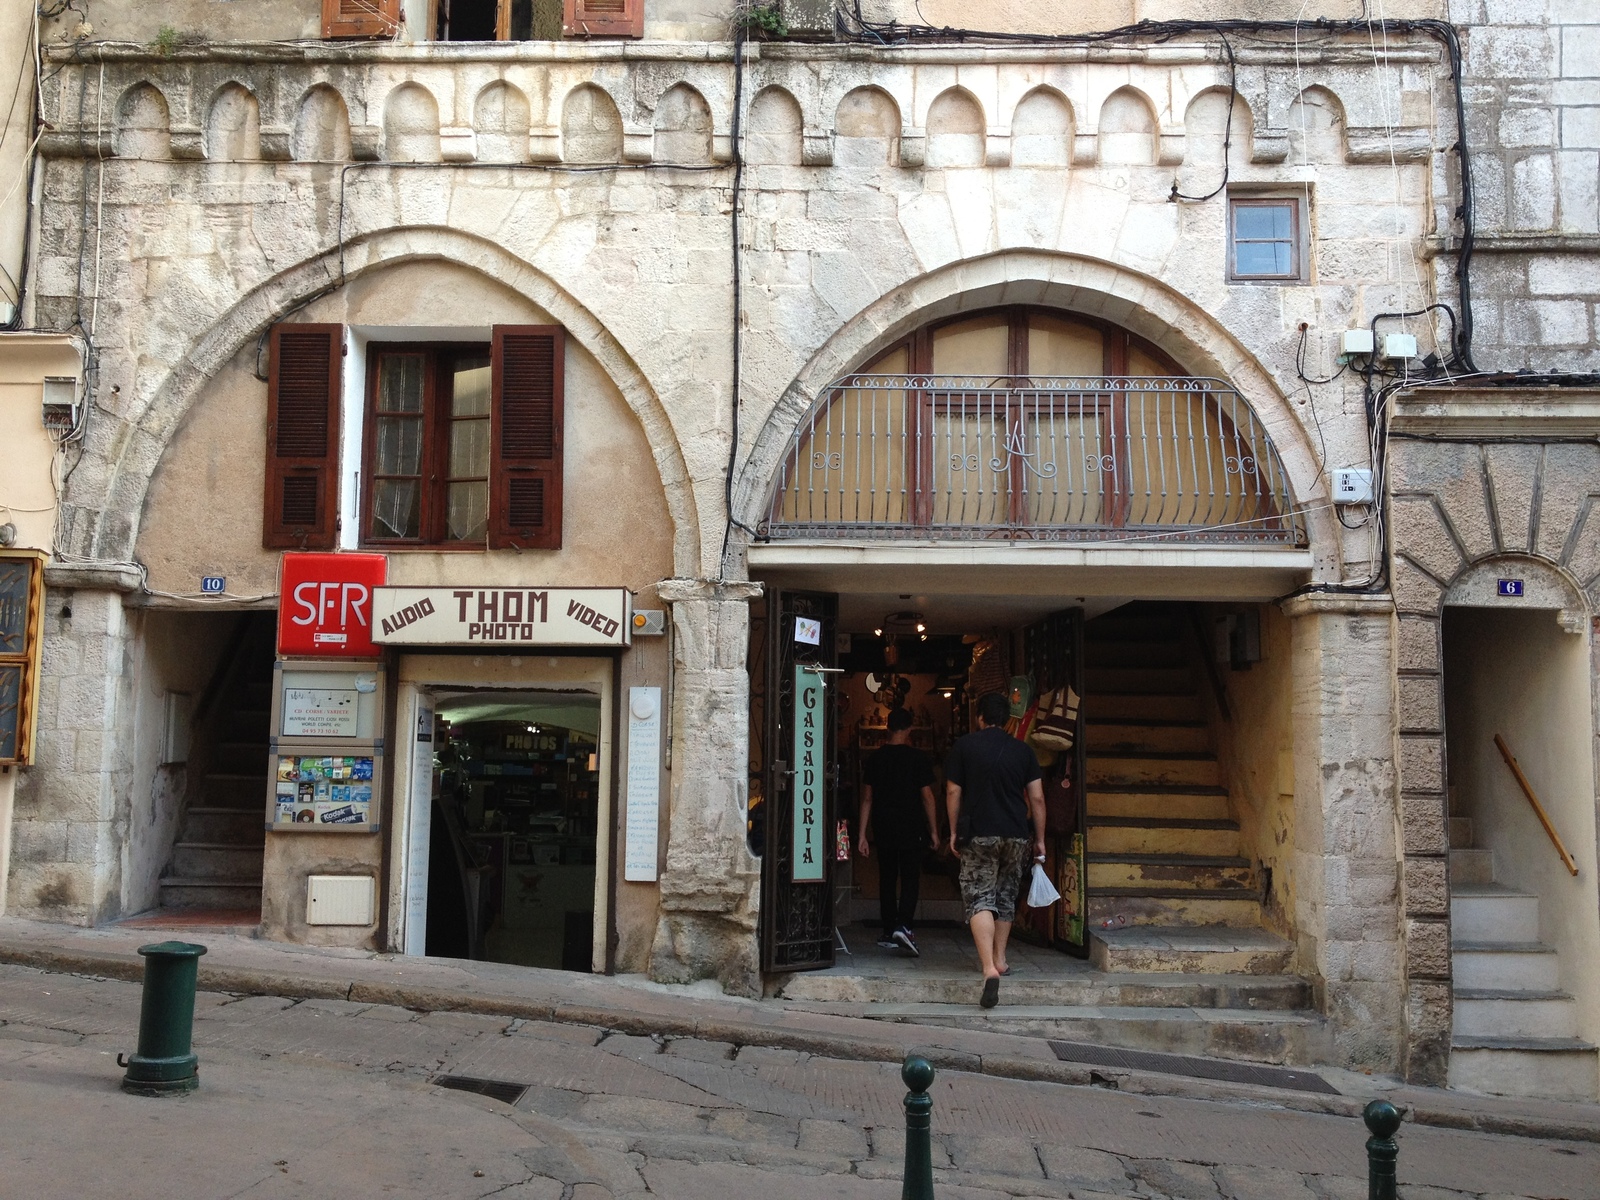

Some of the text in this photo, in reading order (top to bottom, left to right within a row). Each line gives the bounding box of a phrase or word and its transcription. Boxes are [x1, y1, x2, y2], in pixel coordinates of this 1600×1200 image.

[207, 579, 220, 590] 10
[1506, 581, 1516, 594] 6
[291, 582, 368, 626] SFR
[381, 597, 436, 636] AUDIO
[453, 591, 548, 623] THOM
[468, 622, 533, 640] PHOTO
[566, 599, 620, 638] VIDEO
[506, 735, 557, 750] PHOTOS
[802, 687, 815, 864] CASADORIA
[323, 808, 346, 820] Kodak
